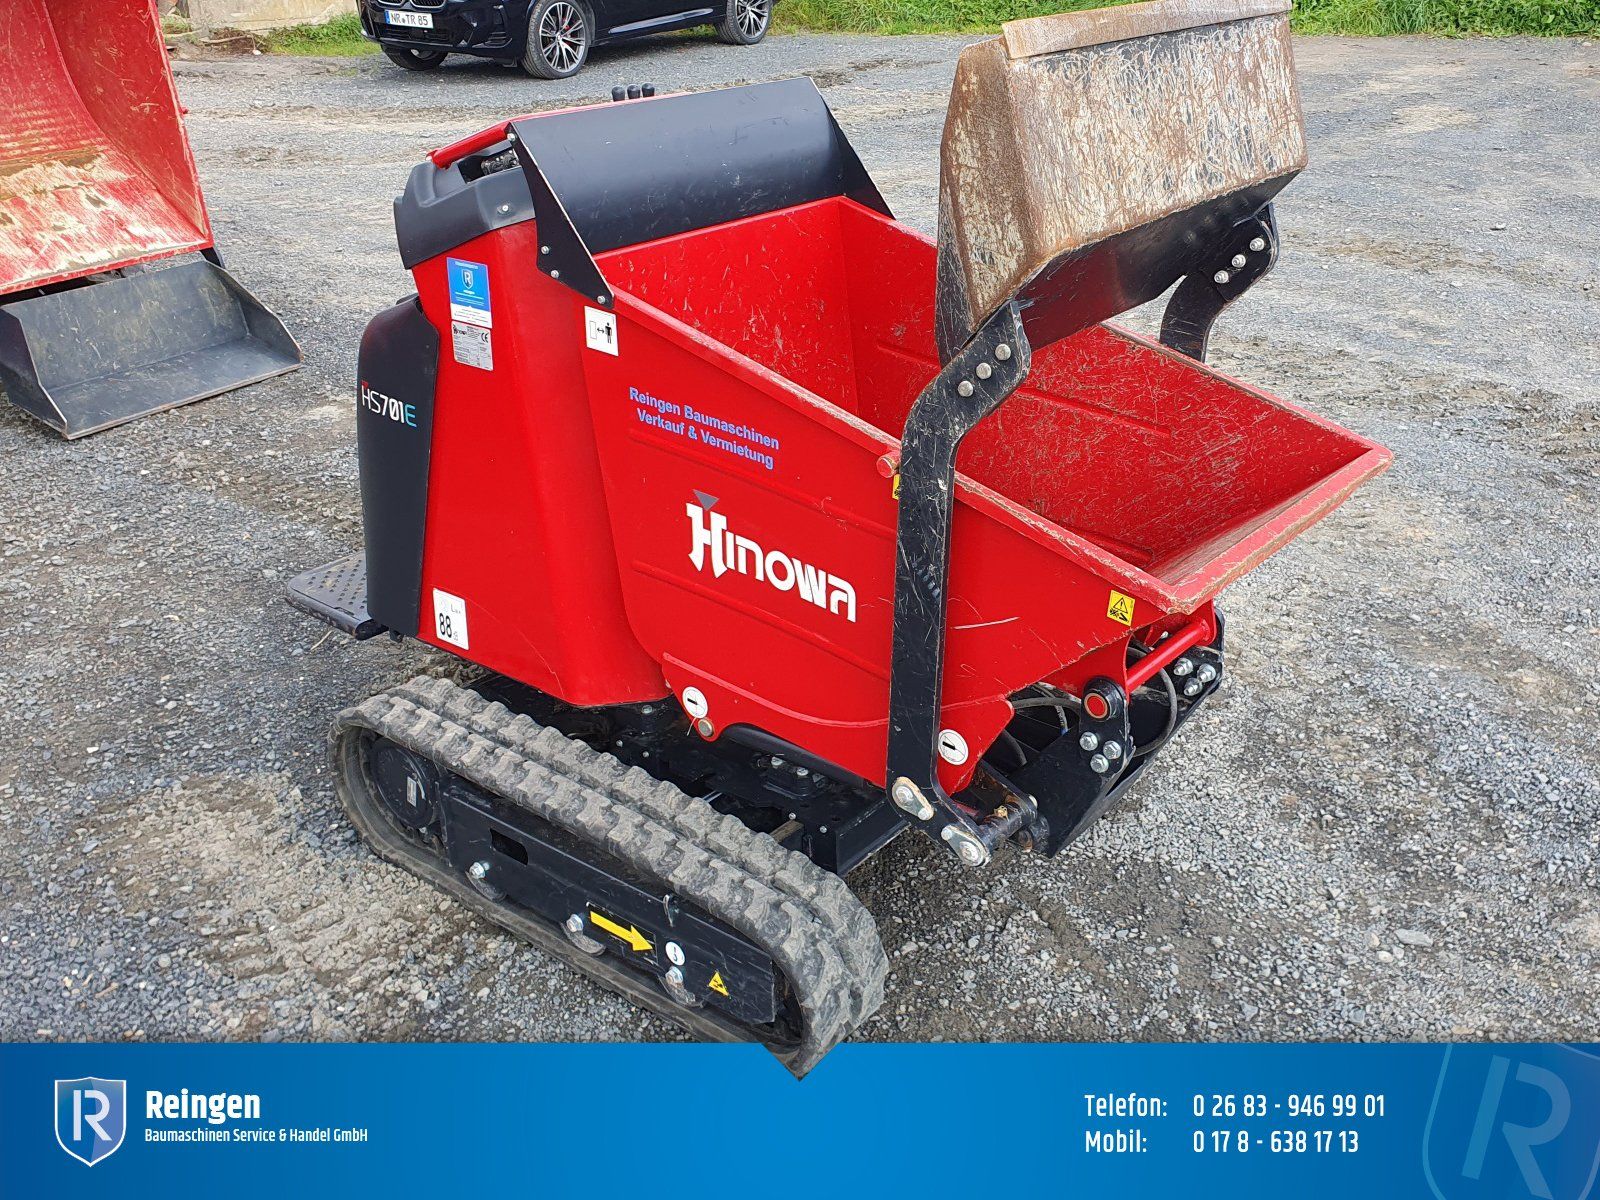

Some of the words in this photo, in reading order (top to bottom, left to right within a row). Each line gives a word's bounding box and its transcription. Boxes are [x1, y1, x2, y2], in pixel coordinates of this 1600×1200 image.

[361, 380, 417, 428] HS701E
[629, 386, 681, 416] Reingen
[683, 404, 780, 450] Baumaschinen
[636, 407, 685, 436] Verkauf
[687, 425, 698, 440] &
[700, 428, 774, 470] Vermietung
[439, 612, 452, 638] 88
